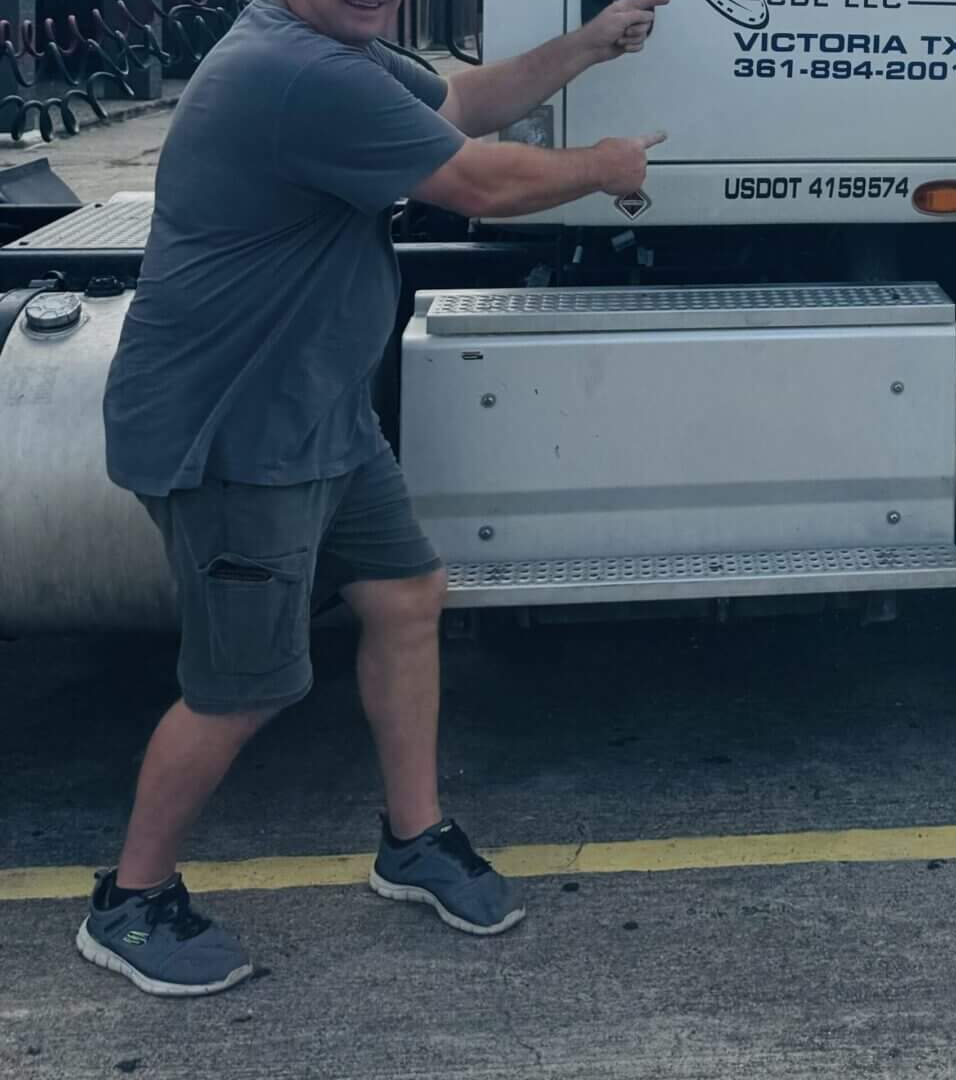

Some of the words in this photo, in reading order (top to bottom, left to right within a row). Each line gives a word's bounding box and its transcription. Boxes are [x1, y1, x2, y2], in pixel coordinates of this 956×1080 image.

[733, 31, 908, 55] VICTORIA
[724, 176, 802, 200] USDOT
[808, 176, 910, 199] 4159574
